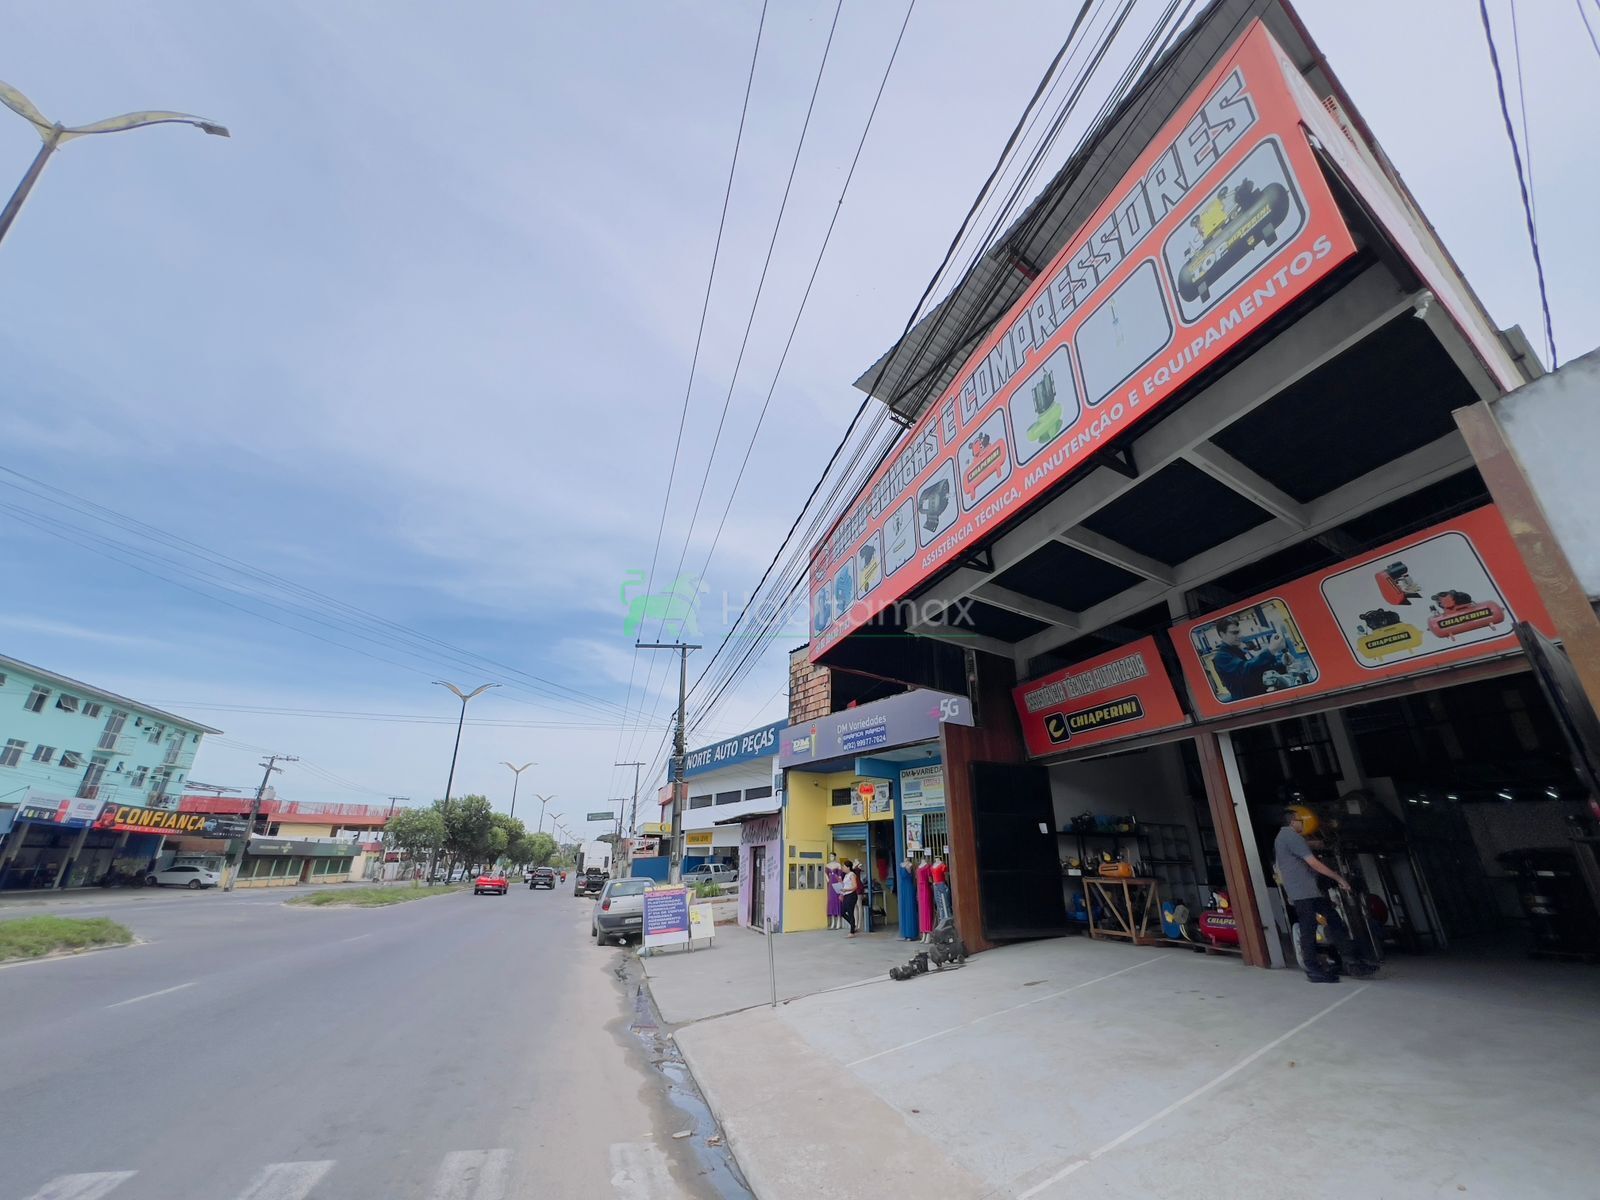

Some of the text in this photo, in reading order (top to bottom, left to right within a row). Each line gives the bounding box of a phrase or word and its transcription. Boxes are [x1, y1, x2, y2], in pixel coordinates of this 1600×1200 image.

[872, 65, 1260, 520] BOMBAS E COMPRESSORES
[922, 523, 974, 569] ASSISTÊNCIA
[1024, 402, 1124, 490] MANUTENÇÃO
[1128, 389, 1140, 408] E
[1142, 234, 1332, 395] EQUIPAMENTOS
[1440, 609, 1490, 627] CHIAPERINI
[1367, 632, 1410, 649] CHIAPERINI
[939, 698, 959, 722] 5G
[1070, 701, 1137, 728] CHIAPERINI
[837, 714, 887, 734] DM Variedades
[687, 728, 775, 770] NORTE AUTO PEÇAS
[114, 806, 207, 831] CONFIANÇA
